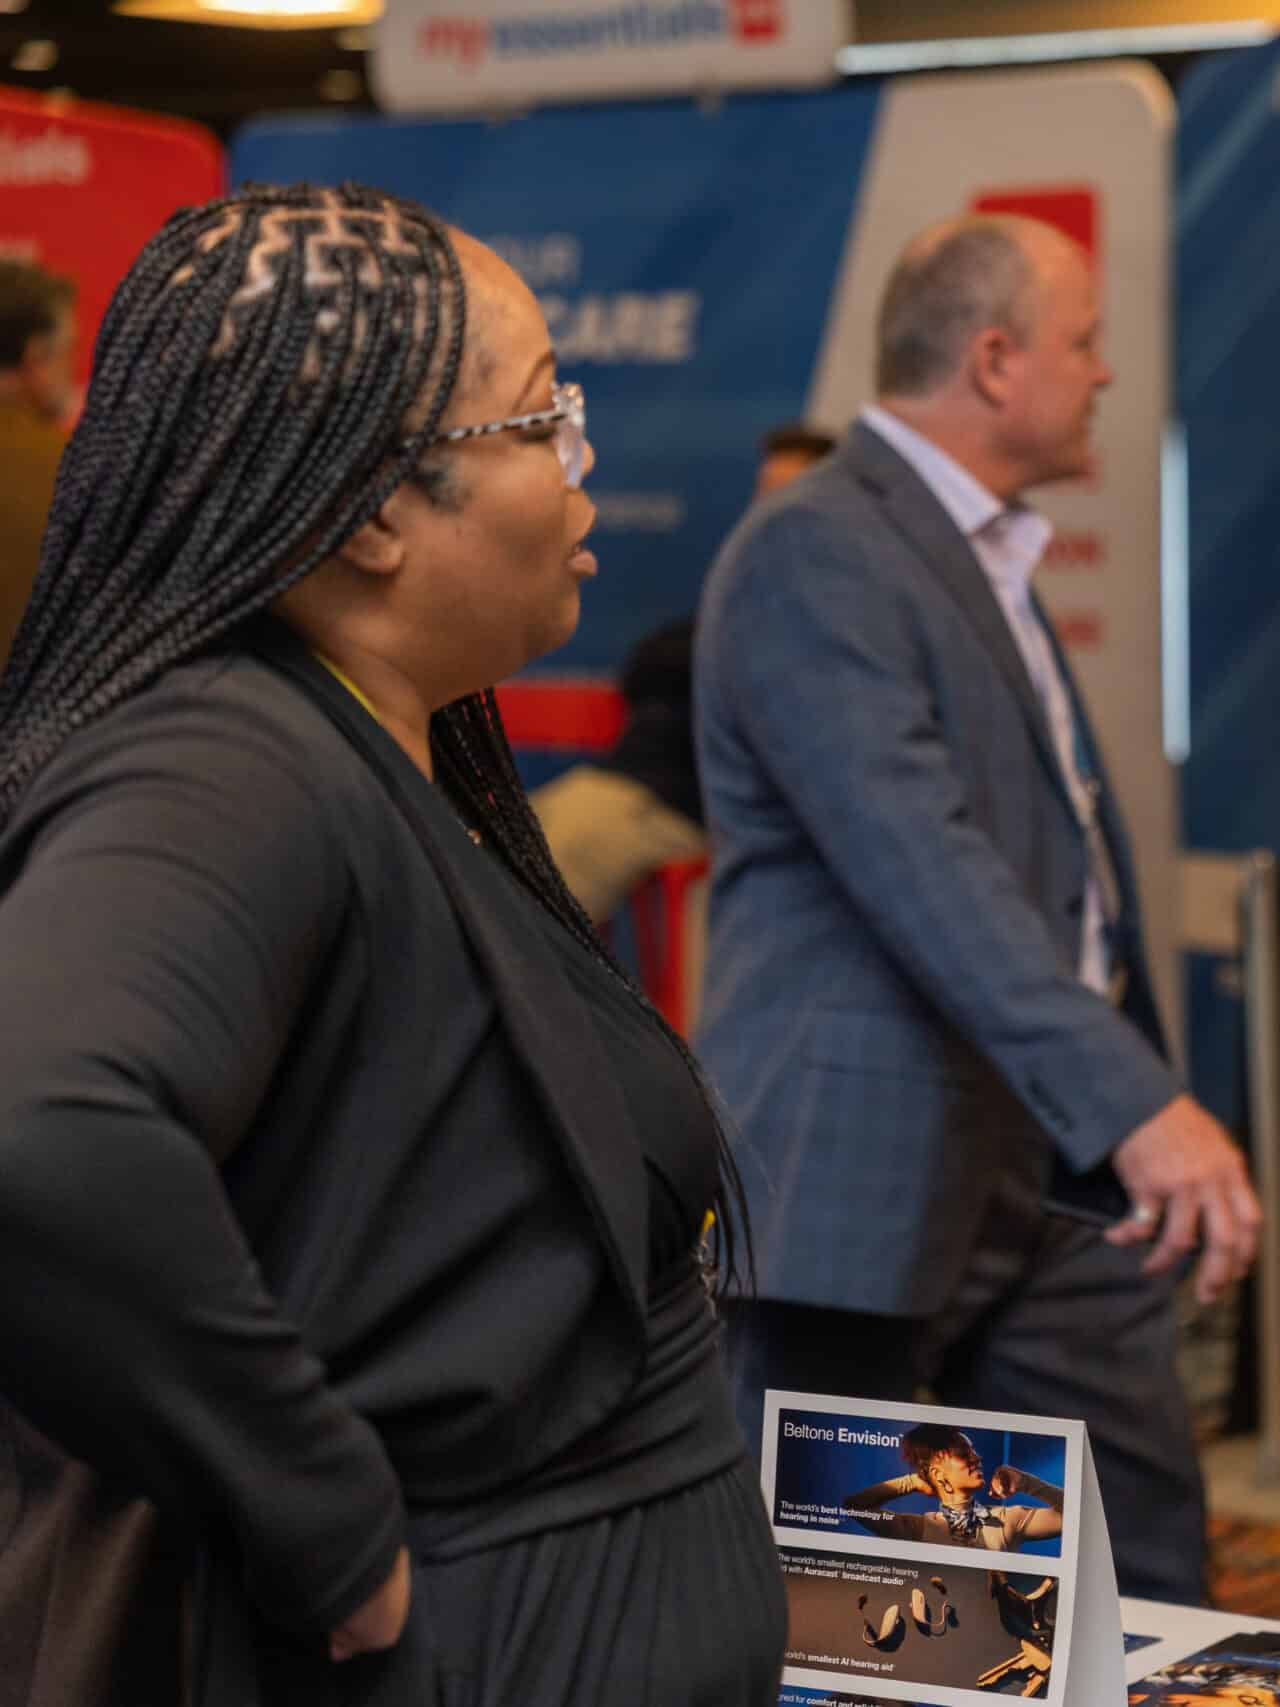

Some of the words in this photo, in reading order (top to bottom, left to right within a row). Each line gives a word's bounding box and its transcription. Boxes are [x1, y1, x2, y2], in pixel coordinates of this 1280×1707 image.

[784, 1422, 834, 1441] Beltone
[780, 1511, 809, 1524] hearing
[781, 1500, 794, 1510] The
[821, 1505, 838, 1515] best
[840, 1507, 882, 1521] technology
[808, 1654, 840, 1666] smallest
[851, 1659, 880, 1671] hearing
